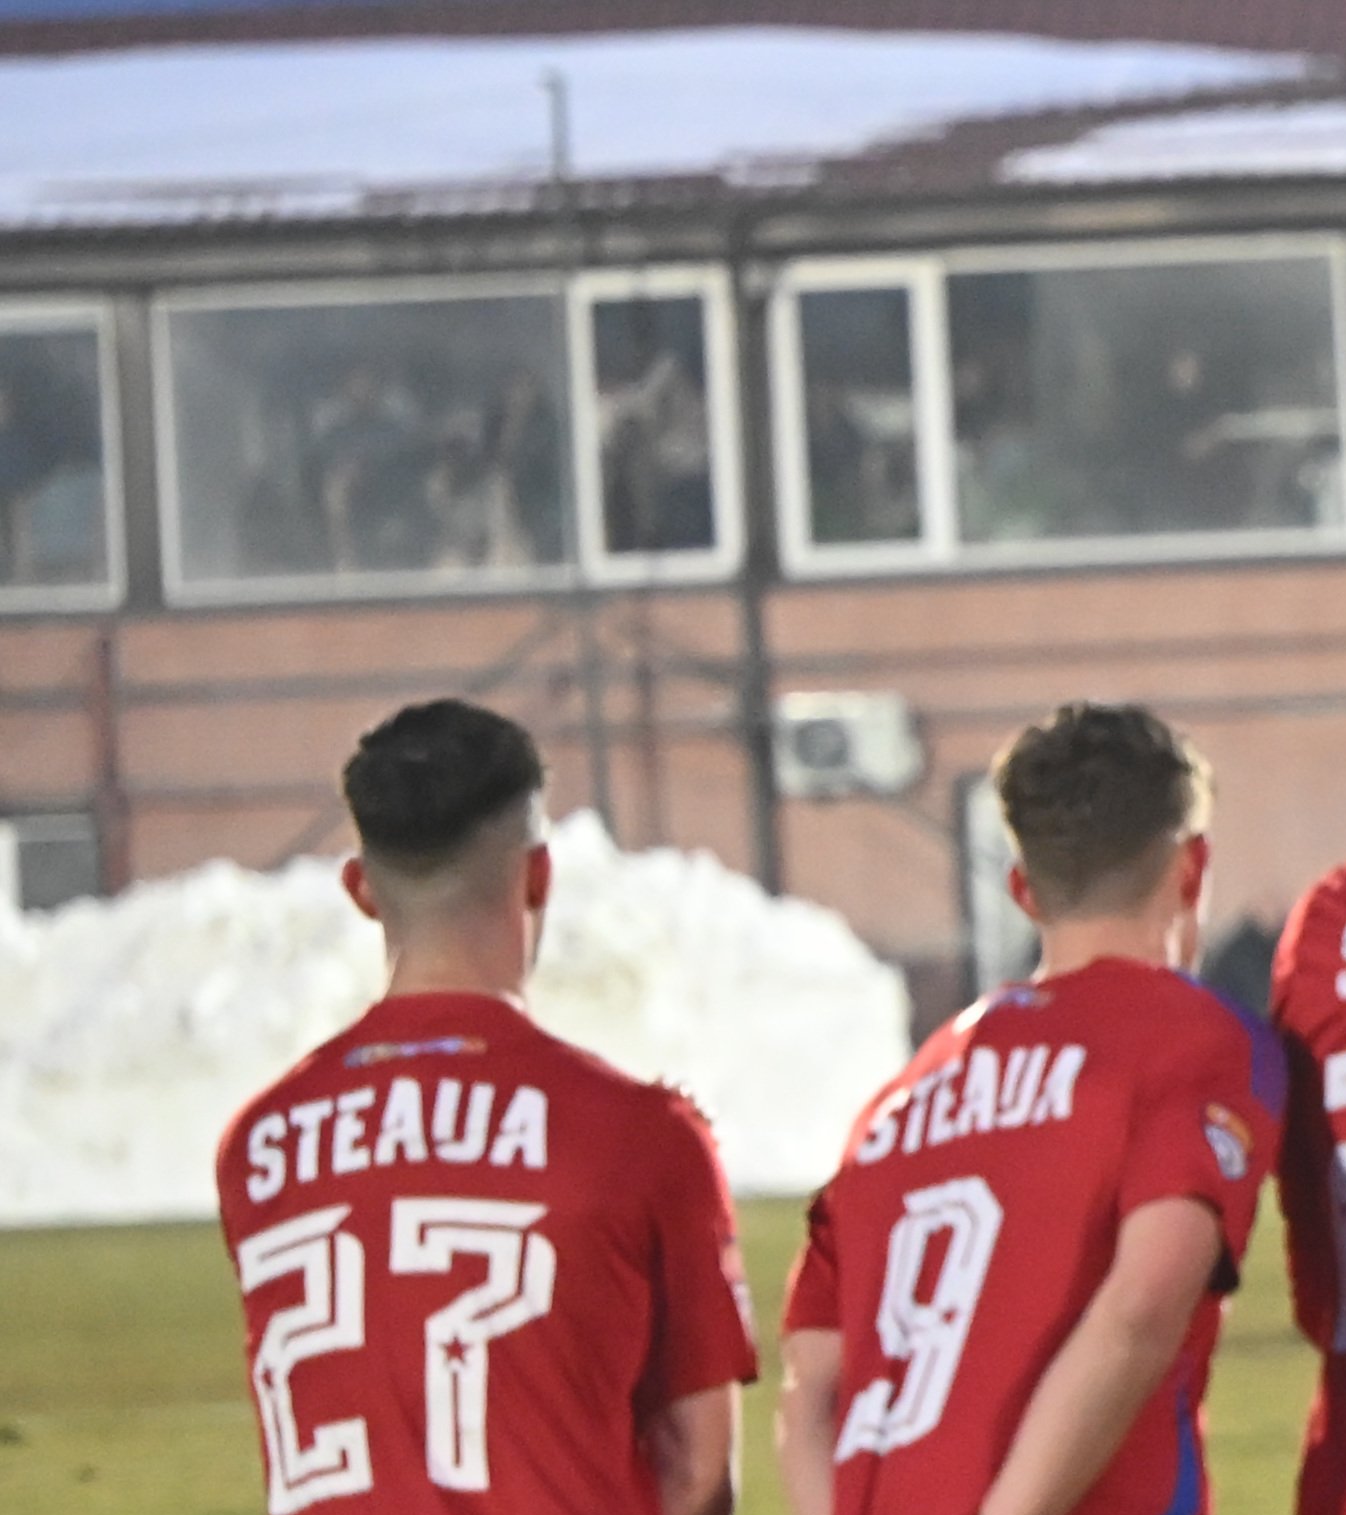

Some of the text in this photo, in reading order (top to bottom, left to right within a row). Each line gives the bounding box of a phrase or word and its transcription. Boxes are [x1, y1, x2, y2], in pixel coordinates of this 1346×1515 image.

[247, 1077, 548, 1203] STEAUA
[856, 1044, 1086, 1165] STEAUA
[834, 1176, 1003, 1464] 9
